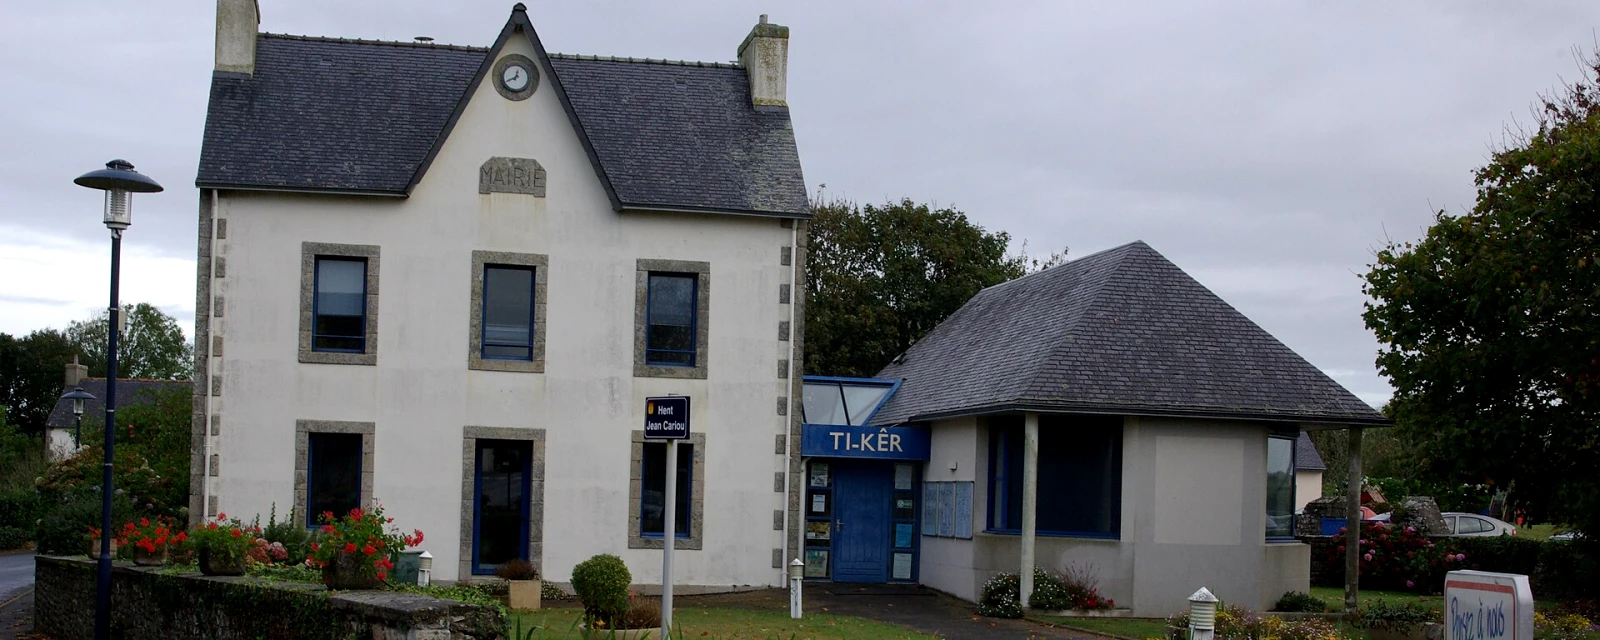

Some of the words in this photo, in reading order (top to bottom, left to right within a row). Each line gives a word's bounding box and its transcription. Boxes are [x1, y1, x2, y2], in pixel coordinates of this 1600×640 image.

[480, 165, 545, 187] MAIRIE
[658, 405, 673, 415] Hent
[646, 420, 662, 430] Jean
[663, 420, 684, 430] Cariou
[829, 427, 903, 452] TI-KÊR
[1487, 599, 1505, 638] nous
